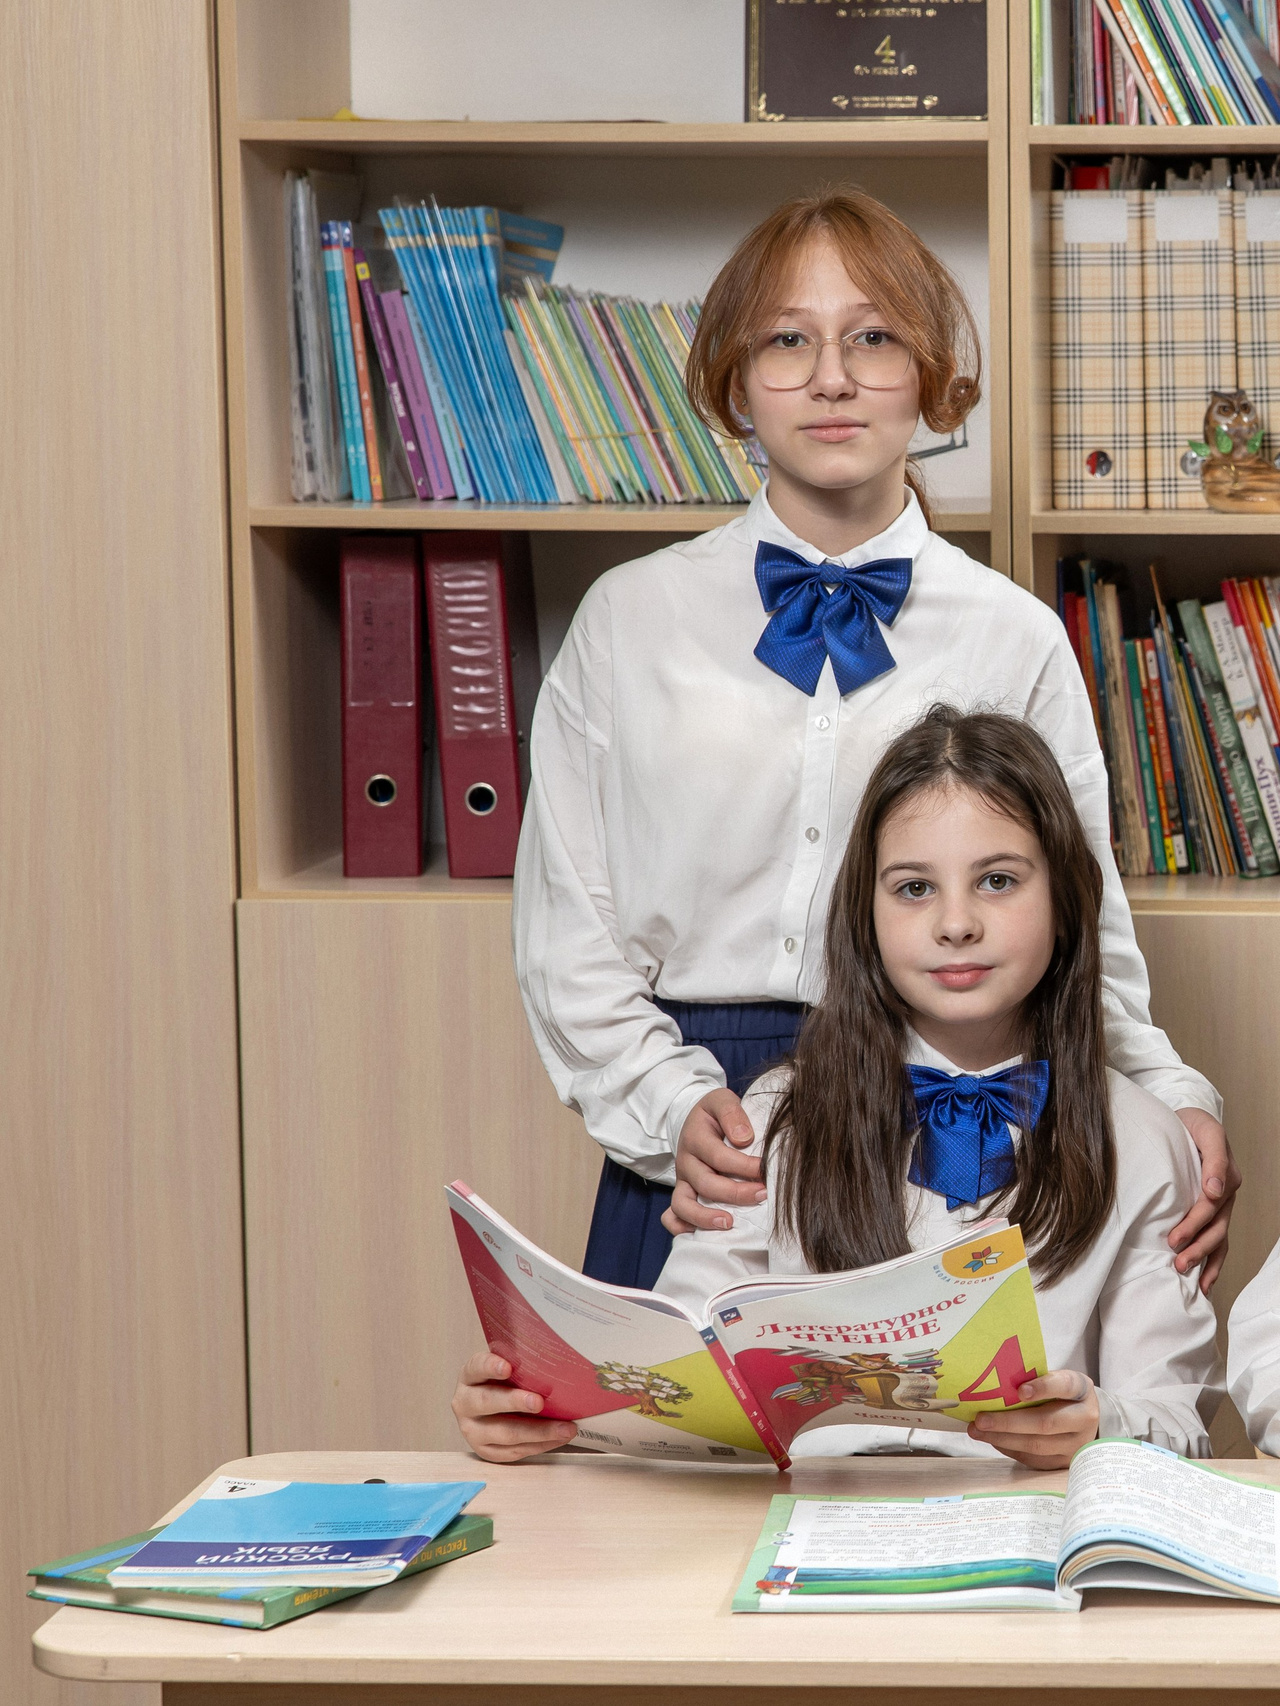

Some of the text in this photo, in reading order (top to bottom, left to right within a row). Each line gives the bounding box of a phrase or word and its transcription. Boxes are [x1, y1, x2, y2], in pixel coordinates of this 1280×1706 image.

[874, 34, 896, 64] 4
[1212, 692, 1237, 748] Флоры
[1229, 751, 1260, 822] Царство
[933, 1264, 995, 1285] ШКОЛА РОССИИ
[756, 1293, 967, 1338] Литературное
[793, 1318, 941, 1344] ЧТЕНИЕ
[958, 1335, 1037, 1407] 4
[854, 1412, 911, 1421] Часть
[227, 1485, 248, 1493] 4
[195, 1552, 352, 1565] РУССКИЙ
[236, 1545, 334, 1555] ЯЗЫК
[421, 1538, 468, 1561] Тексты по
[294, 1587, 329, 1606] чтения
